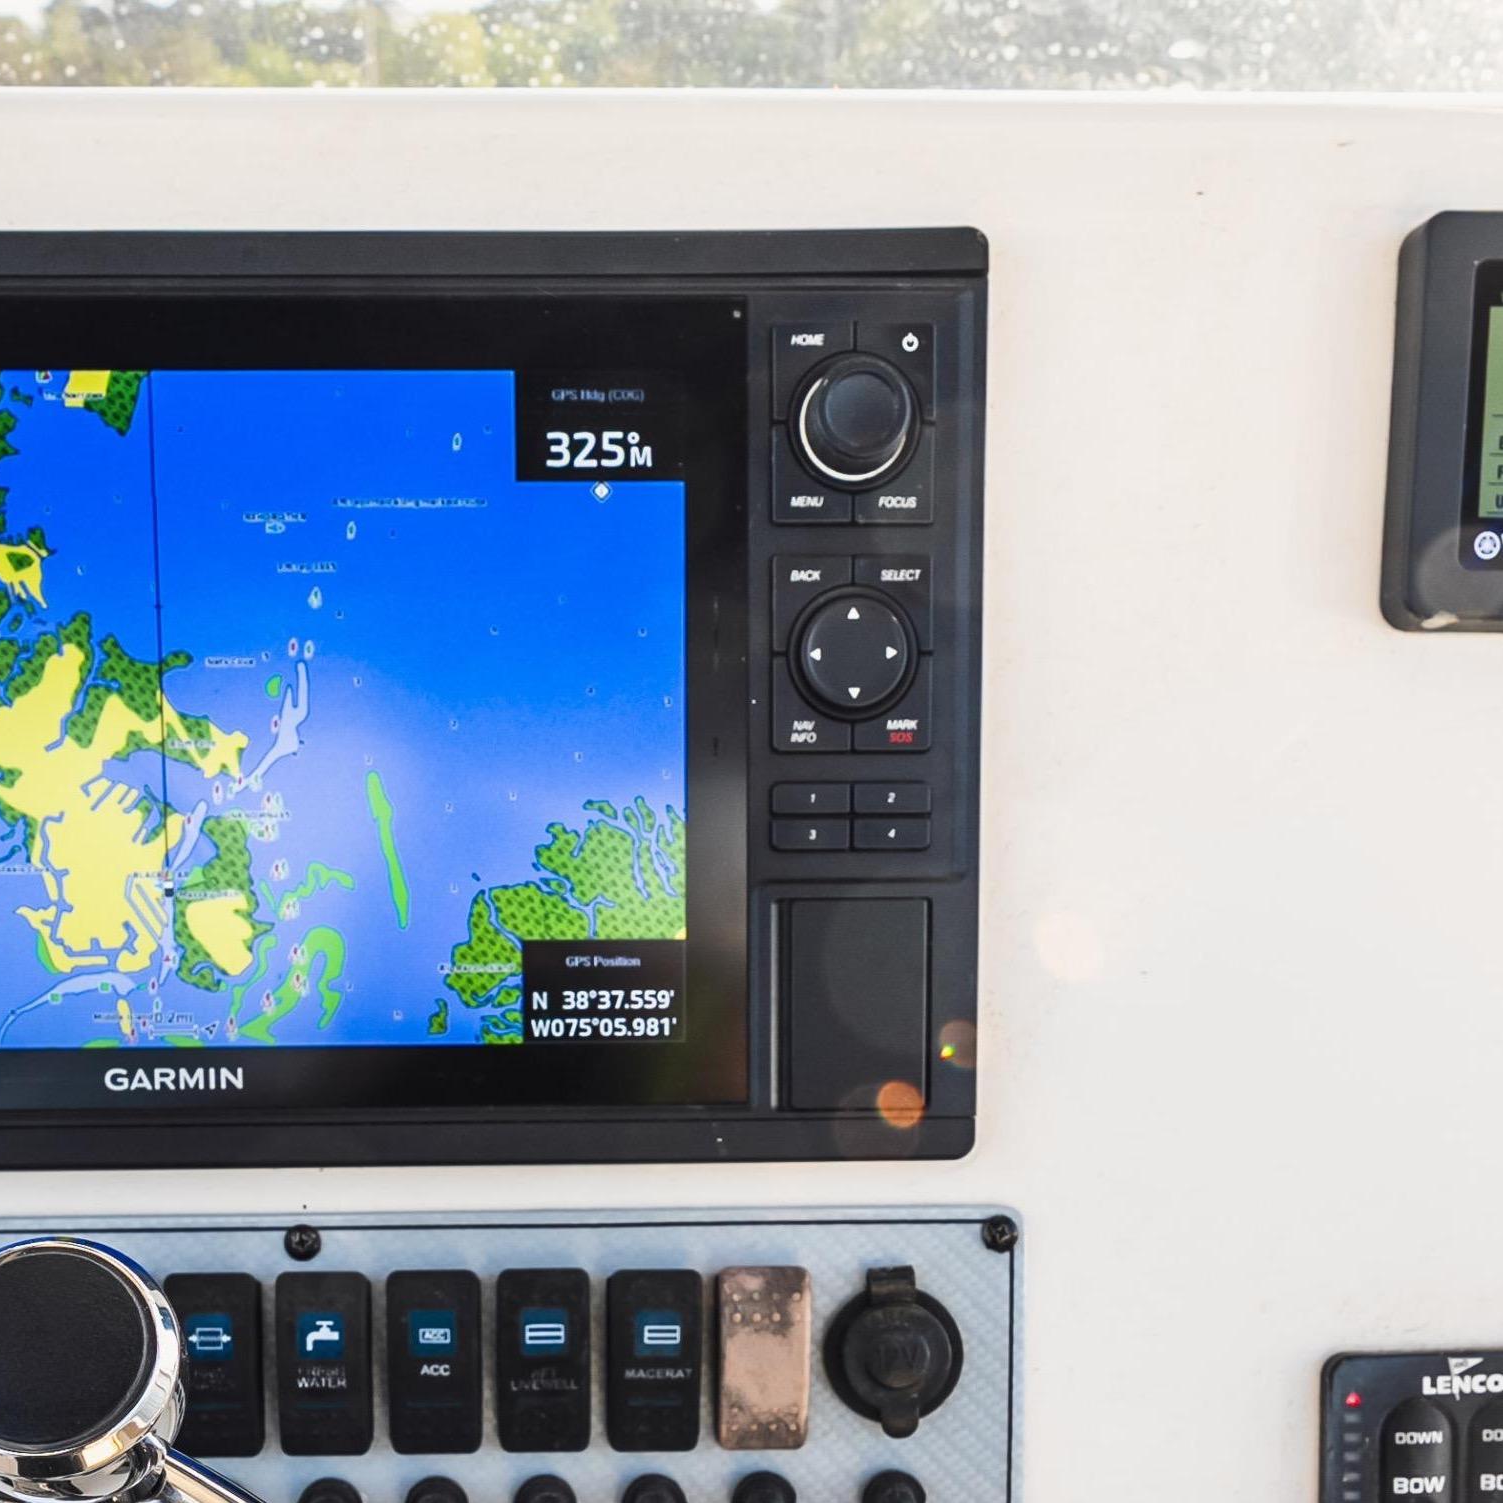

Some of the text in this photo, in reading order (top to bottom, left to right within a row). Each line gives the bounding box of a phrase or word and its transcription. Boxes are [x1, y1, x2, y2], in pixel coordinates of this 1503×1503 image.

[790, 333, 825, 346] HOME
[551, 389, 577, 401] GPS
[789, 496, 825, 508] MENU
[878, 496, 918, 509] FOCUS
[790, 569, 822, 582] BACK
[880, 569, 922, 582] SELECT
[792, 720, 816, 731] NAV
[886, 719, 918, 731] MARK
[790, 731, 817, 744] INFO
[889, 731, 914, 743] SOS
[565, 955, 642, 968] GPS Position
[532, 990, 549, 1011] N
[104, 1066, 245, 1092] GARMIN
[420, 1363, 451, 1377] ACC
[297, 1376, 347, 1388] WATER
[1395, 1430, 1443, 1445] DOWN
[1393, 1475, 1446, 1494] BOW
